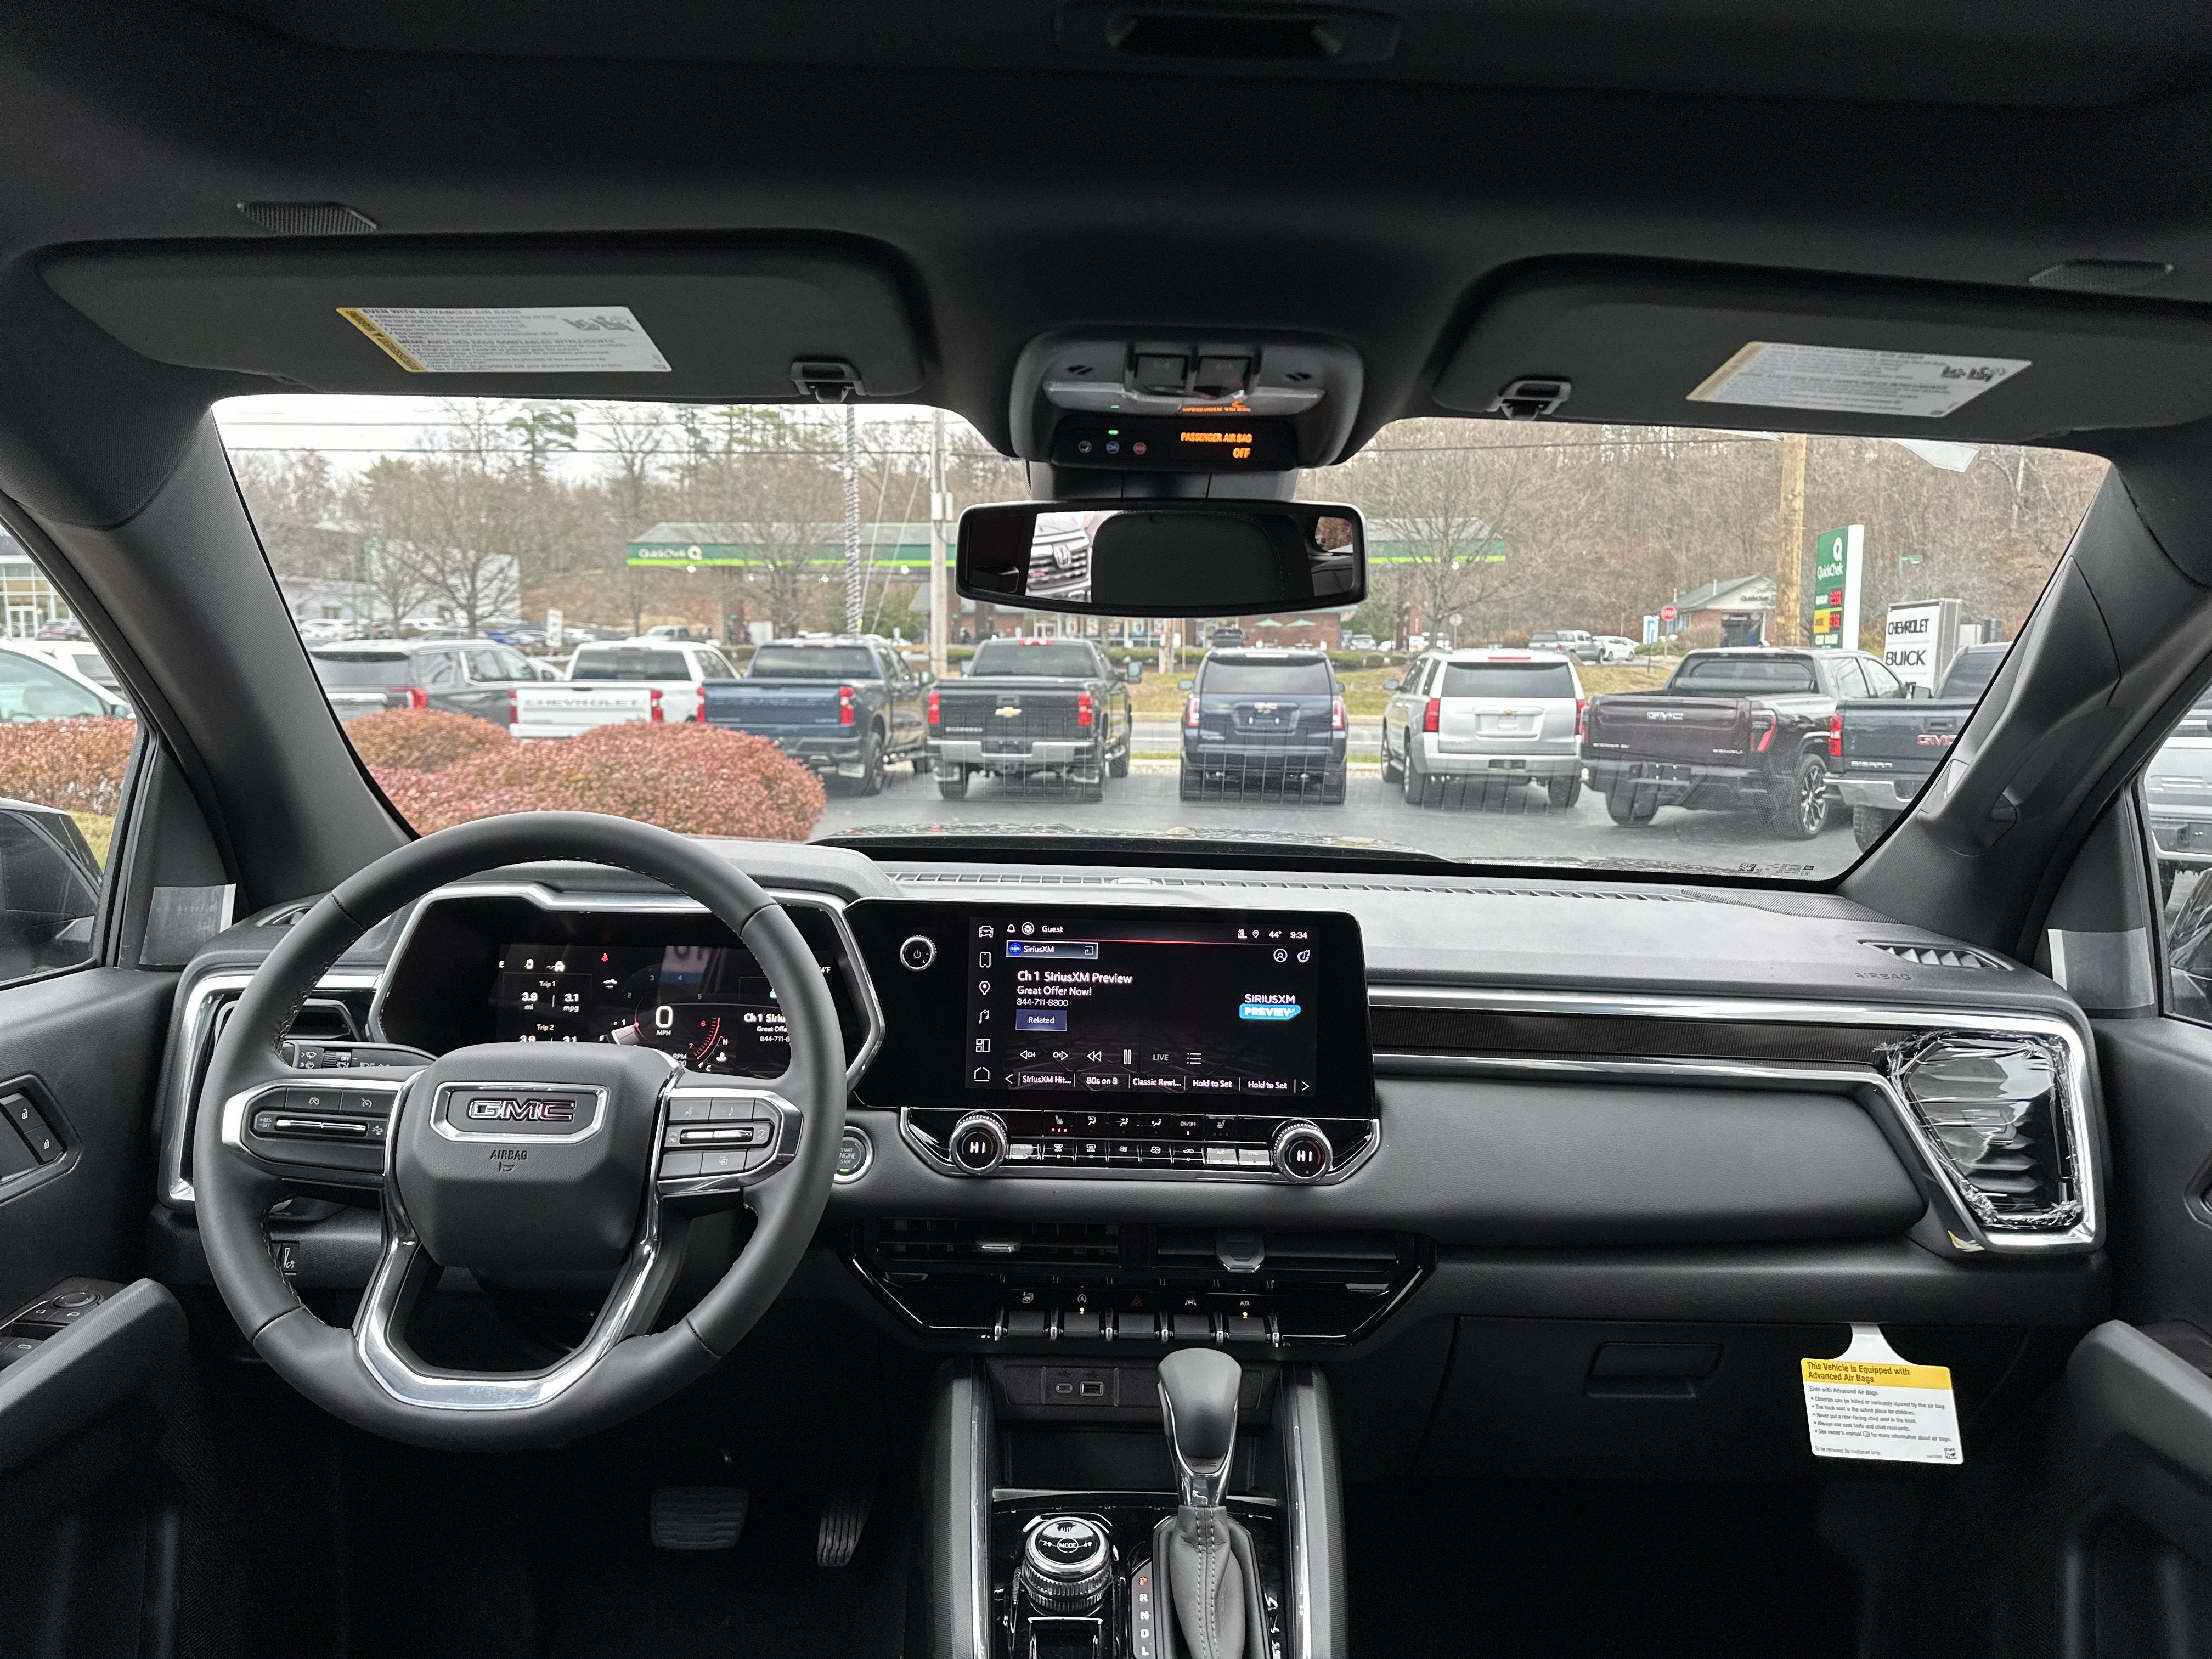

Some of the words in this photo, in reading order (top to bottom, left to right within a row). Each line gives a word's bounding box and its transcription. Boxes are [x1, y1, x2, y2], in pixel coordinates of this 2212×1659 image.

[1181, 432, 1223, 442] PASSENGER
[1233, 447, 1251, 458] OFF
[1817, 561, 1843, 580] QuickChek
[1888, 618, 1929, 635] CHEVROLET
[1886, 650, 1927, 665] BUICK
[1646, 711, 1684, 720] GMC
[1917, 734, 1958, 746] GMC
[1850, 760, 1893, 769] SIERRA
[1290, 931, 1308, 939] 9:34
[1023, 945, 1054, 953] SiriusXM
[499, 960, 505, 968] E
[1017, 970, 1032, 981] Ch
[1034, 971, 1040, 981] 1
[1043, 971, 1090, 983] SiriusXM
[1092, 972, 1133, 984] Preview
[1854, 972, 1912, 981] AIRBAG
[1017, 986, 1042, 995] Great
[1043, 986, 1068, 995] Offer
[1069, 987, 1092, 996] Now!
[521, 992, 539, 1001] 3.9
[564, 993, 579, 1002] 3.1
[1245, 994, 1296, 1004] SIRIUSXM
[1017, 998, 1068, 1007] 844-711-8800
[563, 1005, 579, 1013] mpg
[1244, 1007, 1296, 1017] PREVIEW
[655, 1005, 674, 1028] 0
[744, 1013, 757, 1022] Ch
[758, 1013, 763, 1022] 1
[765, 1013, 786, 1023] Siriu
[537, 1024, 549, 1032] Trip
[1022, 1075, 1053, 1084] SiriusXM
[1054, 1075, 1071, 1084] Hit...
[1086, 1076, 1101, 1085] 80s
[1112, 1077, 1119, 1085] 8
[1132, 1077, 1157, 1086] Classic
[1193, 1079, 1210, 1087] Hold
[1248, 1081, 1265, 1089] Hold
[1275, 1081, 1288, 1090] Set
[468, 1098, 575, 1121] GMC
[970, 1142, 986, 1153] HI
[490, 1149, 528, 1160] AIRBAG
[1297, 1150, 1312, 1162] HI
[1807, 1362, 1821, 1370] This
[1823, 1363, 1849, 1372] Vehicle
[1859, 1365, 1892, 1375] Equipped
[1894, 1367, 1910, 1375] with
[1808, 1371, 1842, 1381] Advanced
[1844, 1373, 1854, 1381] Air
[1856, 1374, 1874, 1384] Bags
[1139, 1577, 1148, 1586] P
[1139, 1593, 1148, 1602] R
[1139, 1611, 1149, 1620] N
[1140, 1628, 1149, 1638] D
[1141, 1646, 1149, 1656] L
